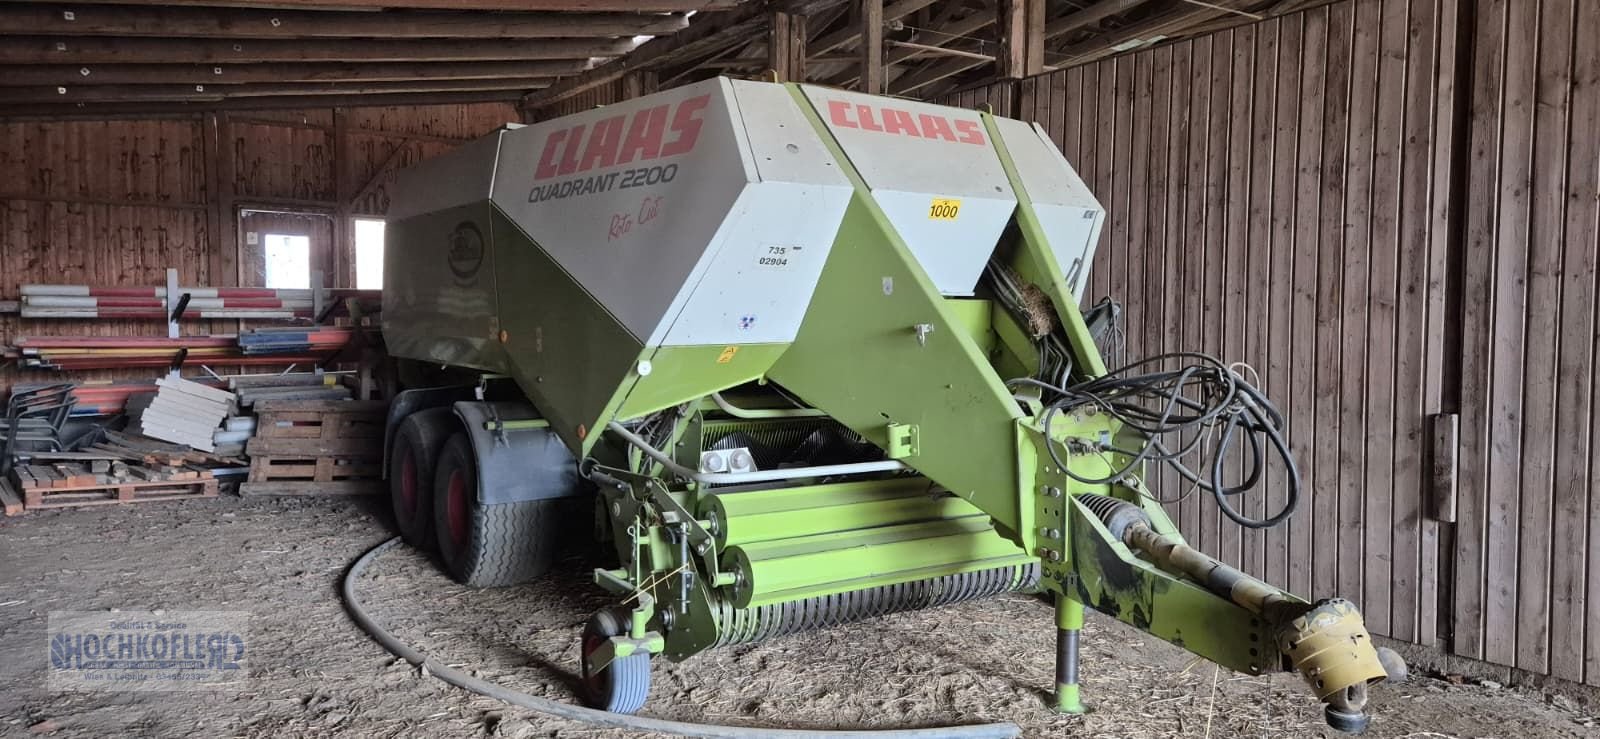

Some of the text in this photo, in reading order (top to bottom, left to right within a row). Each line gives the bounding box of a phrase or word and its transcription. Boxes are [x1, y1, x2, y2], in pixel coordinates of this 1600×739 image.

[534, 93, 711, 180] CLAAS
[828, 100, 985, 146] CLAAS
[528, 163, 678, 203] QUADRANT 2200
[608, 196, 664, 242] Roto Cut
[930, 204, 958, 218] 1000
[759, 257, 787, 265] 02904
[769, 246, 786, 254] 735
